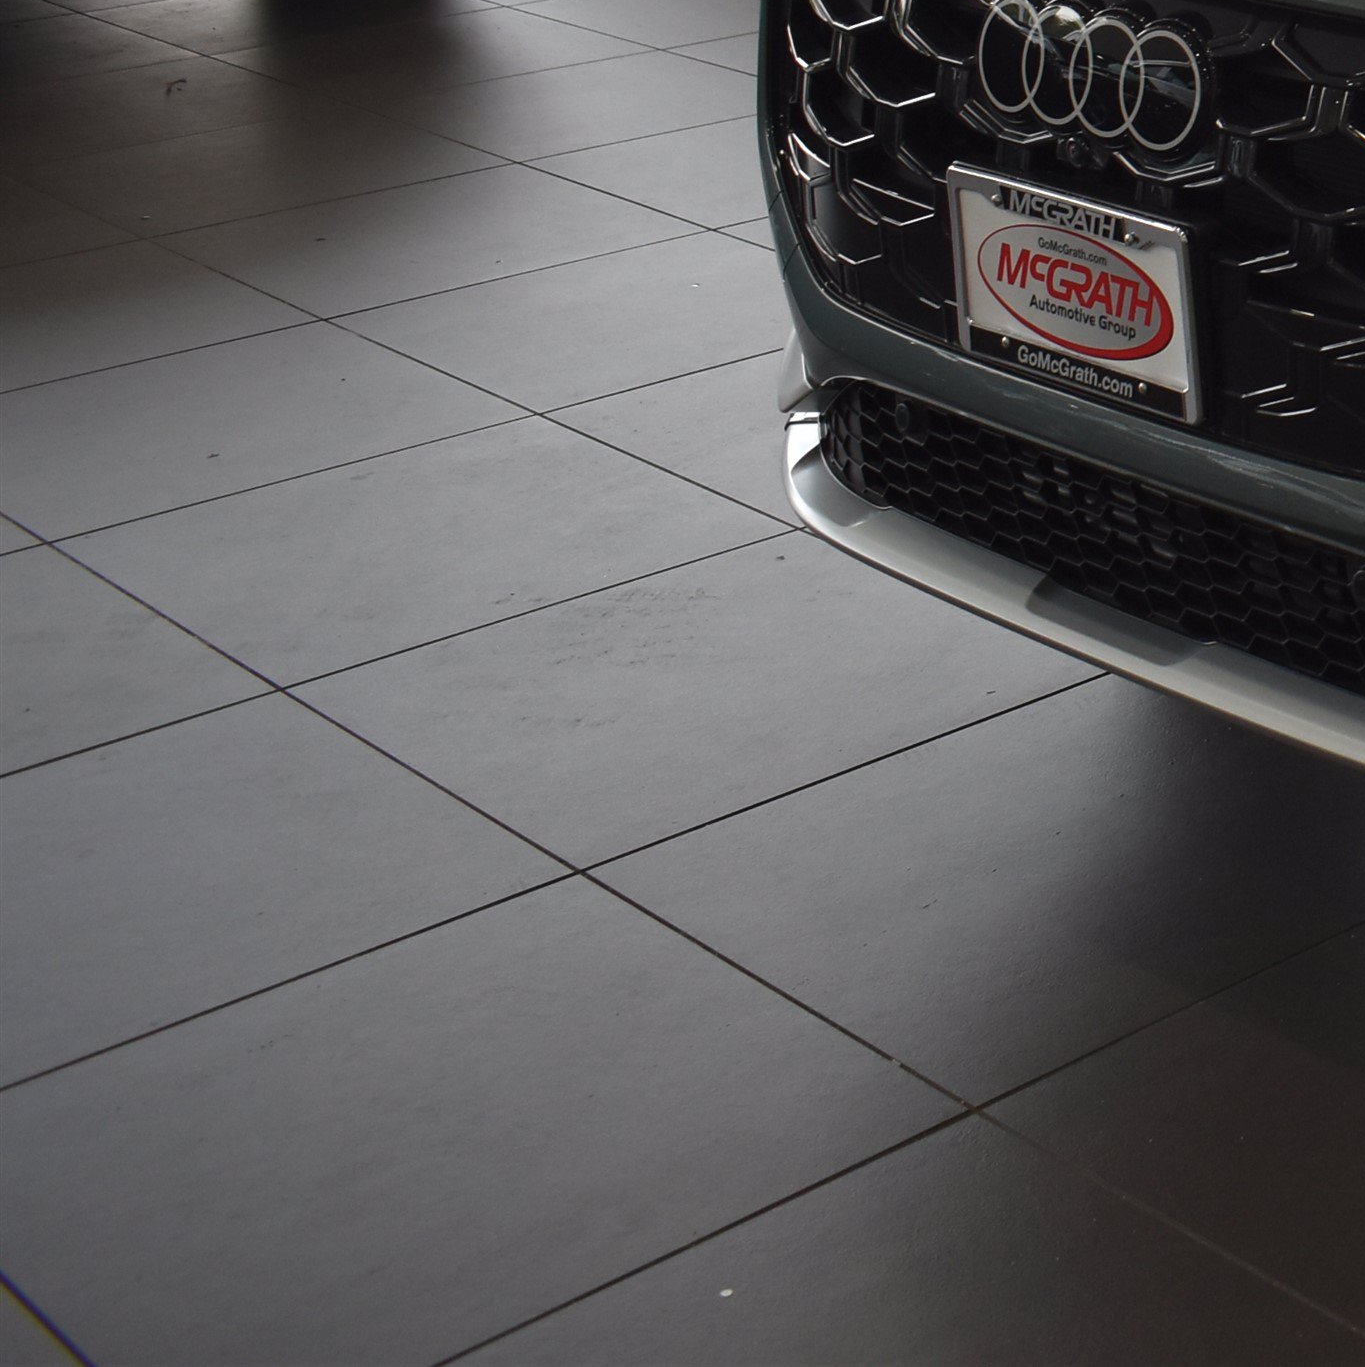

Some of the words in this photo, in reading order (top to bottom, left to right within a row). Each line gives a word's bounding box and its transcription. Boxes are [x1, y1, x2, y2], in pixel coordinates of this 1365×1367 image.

[1038, 237, 1108, 266] GoMcGrath.com
[1029, 294, 1096, 327] Automotive
[1100, 315, 1137, 340] Group
[1017, 344, 1134, 398] GoMcGrath.com
